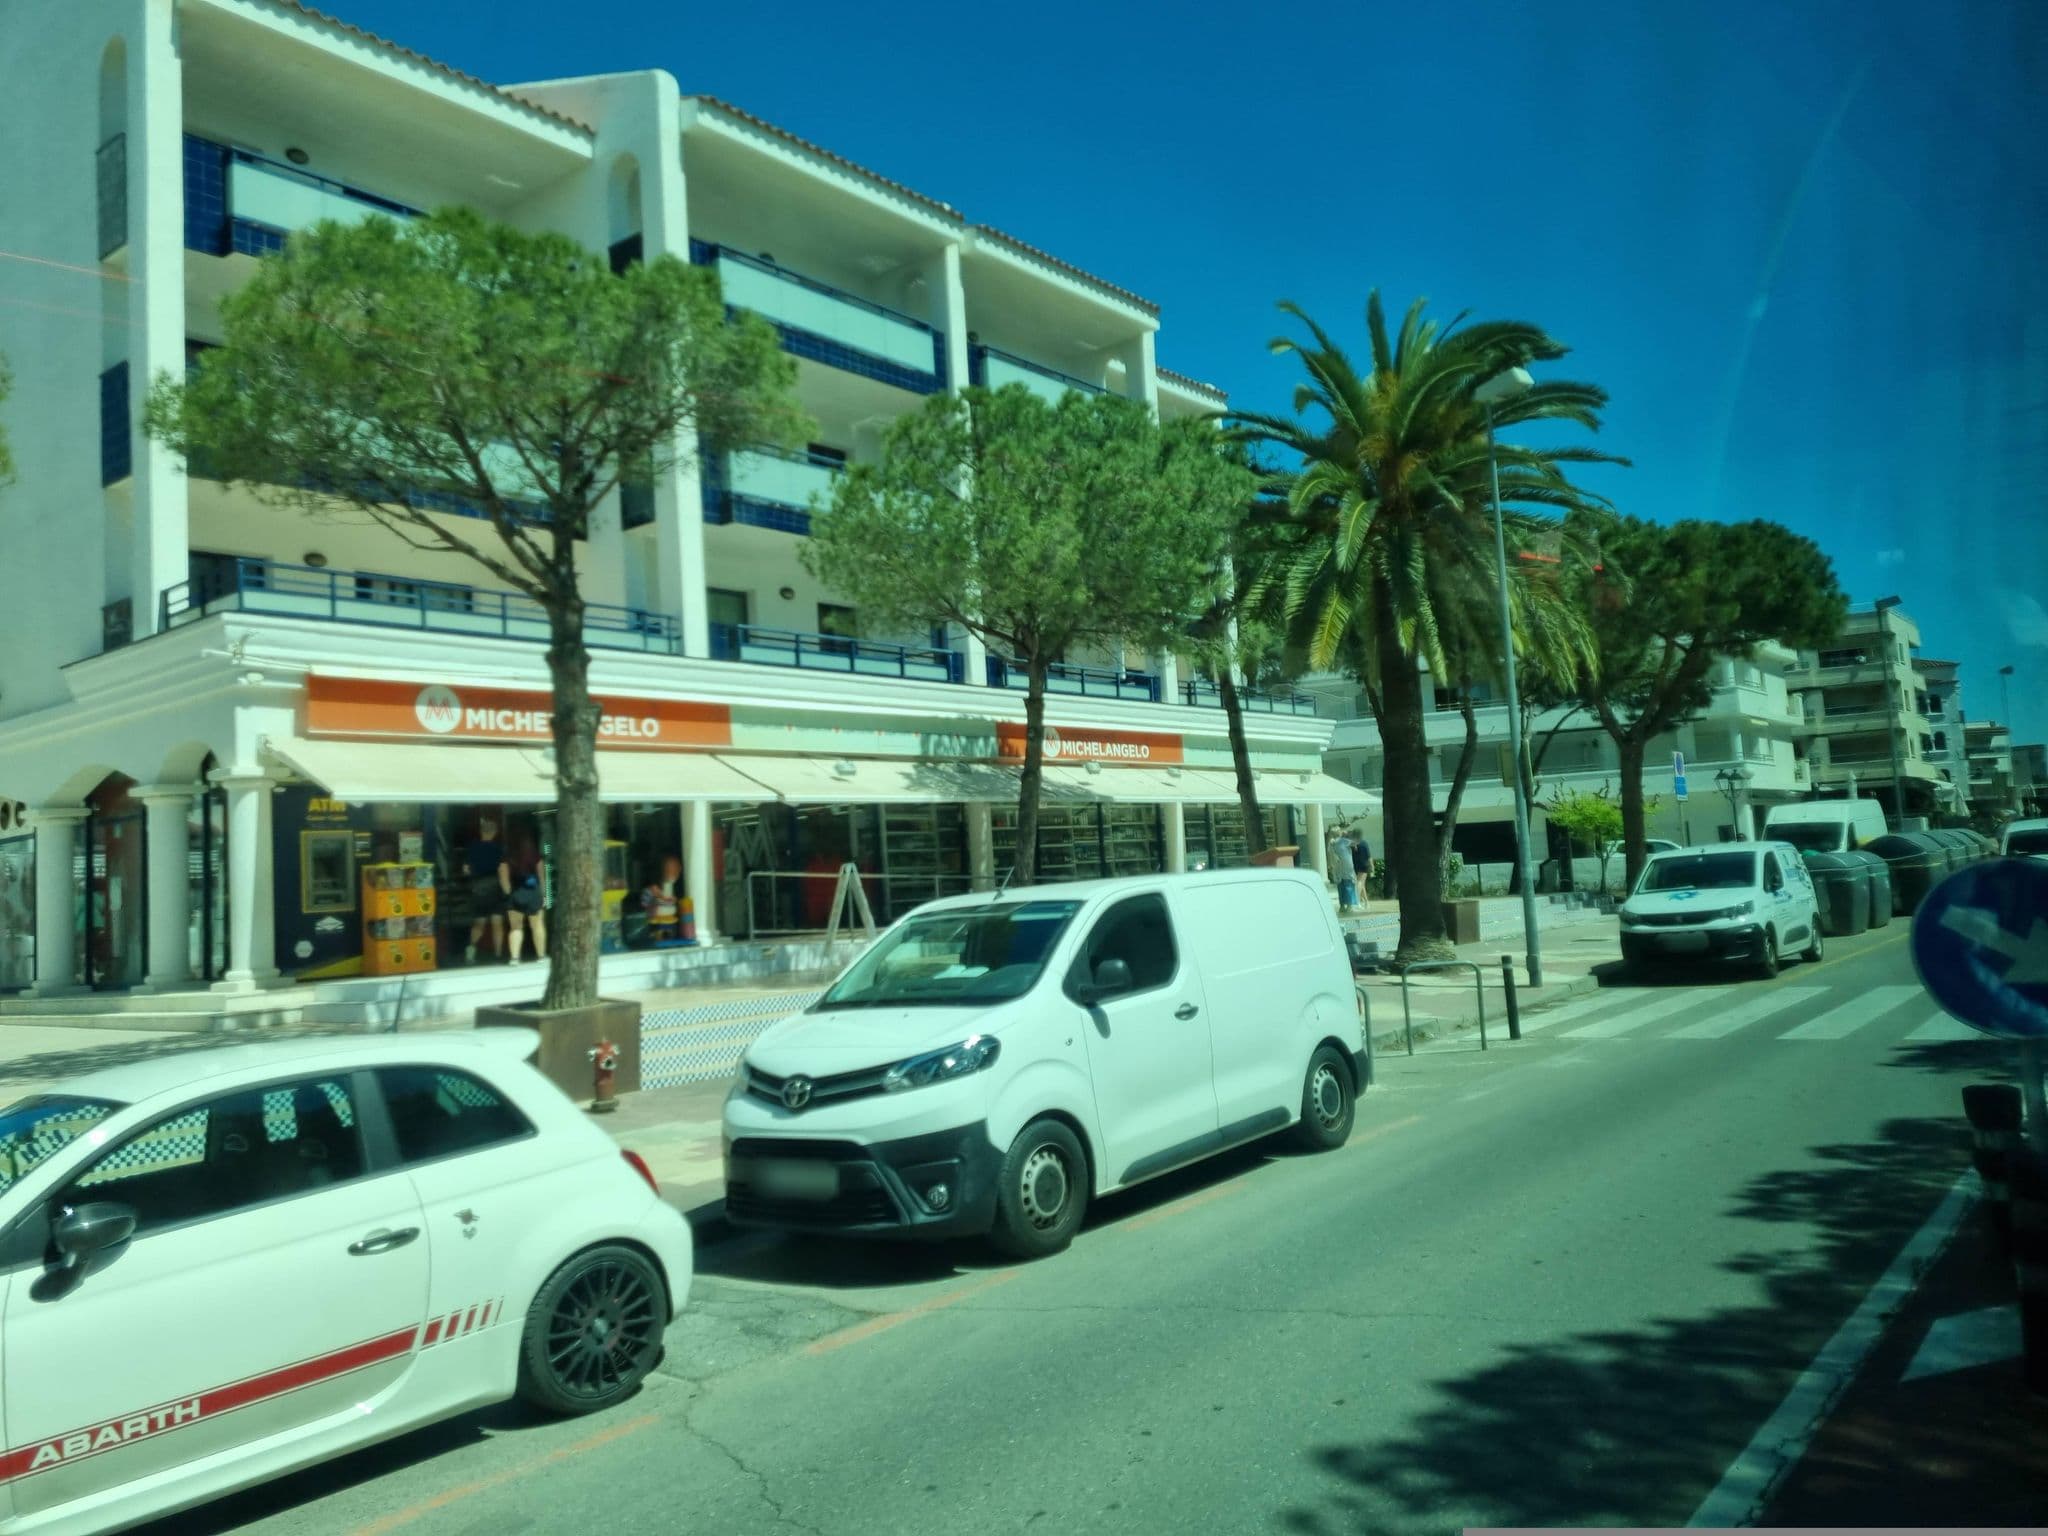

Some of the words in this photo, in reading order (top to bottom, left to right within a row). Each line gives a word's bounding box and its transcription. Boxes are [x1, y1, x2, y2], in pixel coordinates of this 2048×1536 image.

[465, 708, 660, 738] MICHEGELO
[1062, 740, 1150, 758] MICHELANGELO
[308, 796, 347, 812] ATM
[29, 1398, 201, 1470] ABARTH
